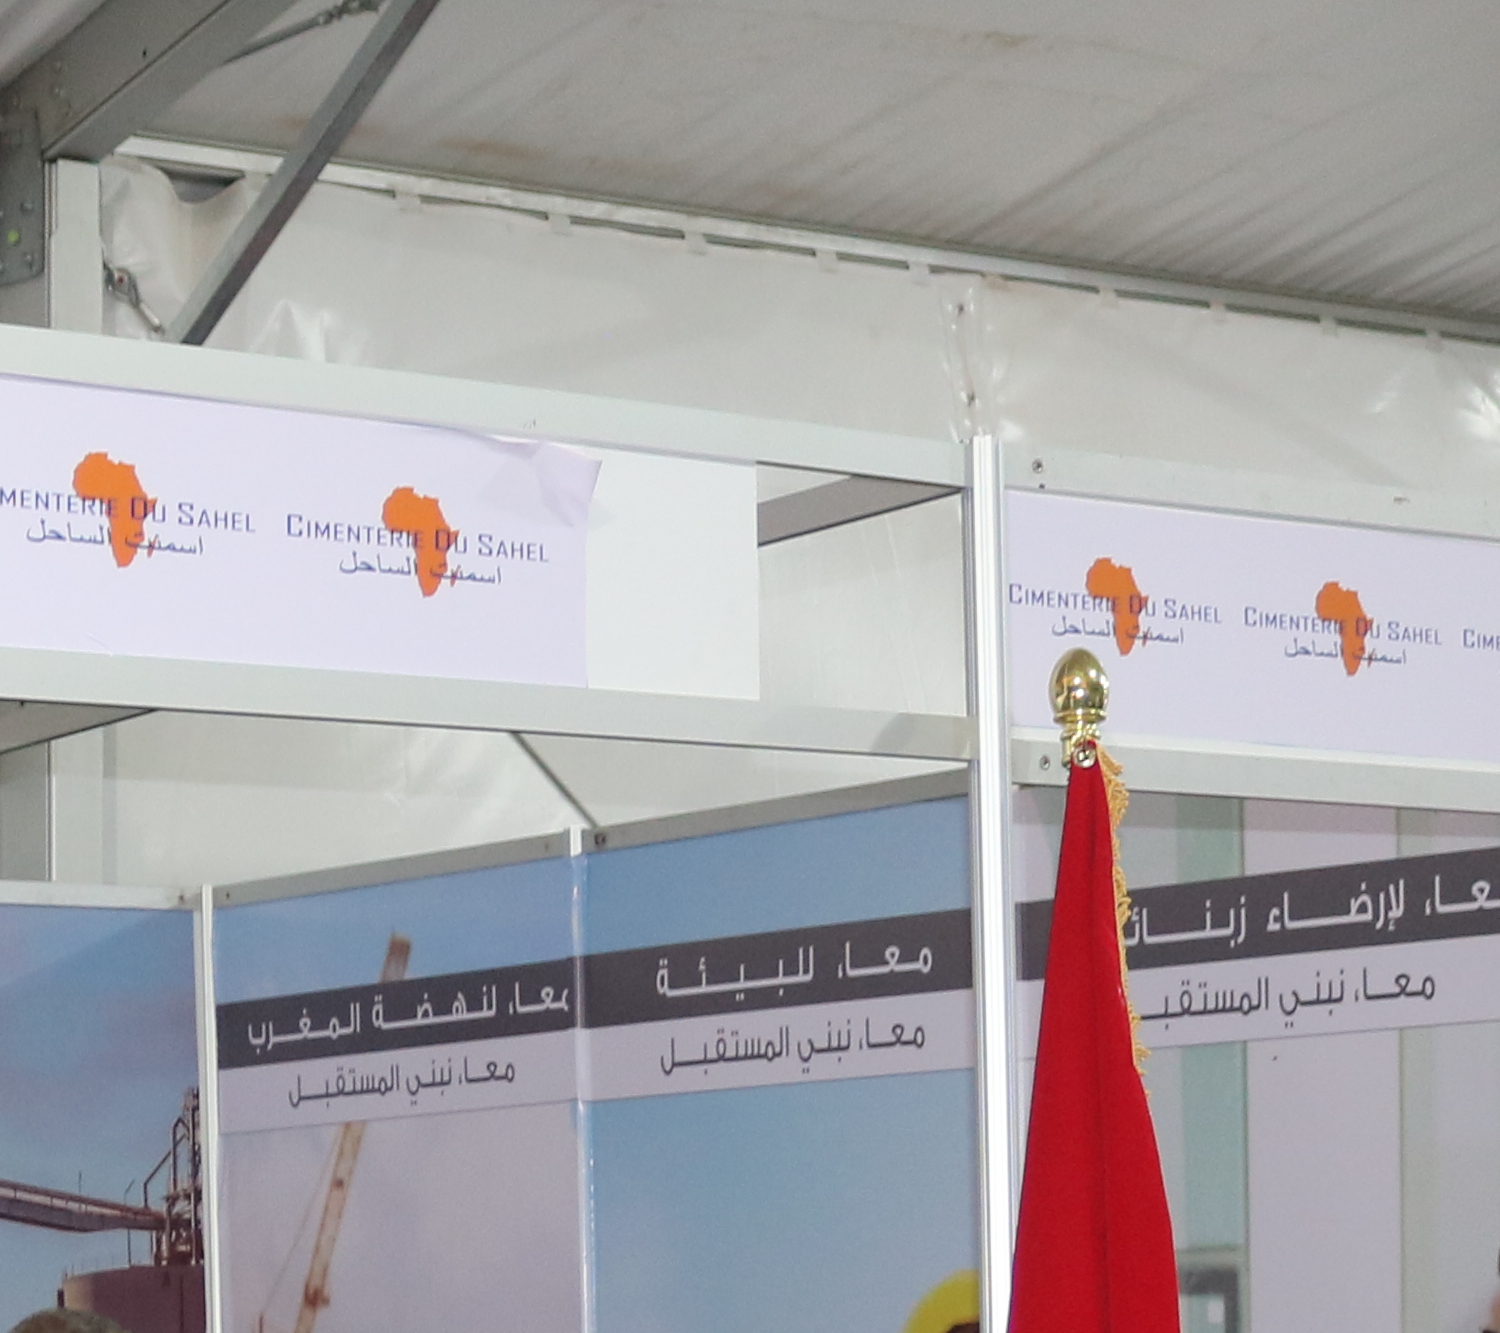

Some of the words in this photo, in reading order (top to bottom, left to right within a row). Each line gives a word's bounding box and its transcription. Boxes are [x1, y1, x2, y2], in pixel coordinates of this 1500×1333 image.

[1266, 878, 1404, 931] لإرضاء
[656, 947, 815, 1004] للبيئة
[1279, 968, 1344, 1028] نبني
[248, 1003, 360, 1050] المغرب
[372, 981, 497, 1027] لنهضة
[1141, 976, 1269, 1030] المستقب
[661, 1026, 790, 1077] المستقبل
[799, 1020, 852, 1075] نبني
[289, 1066, 400, 1109] المستقبل
[406, 1058, 453, 1107] نبني
